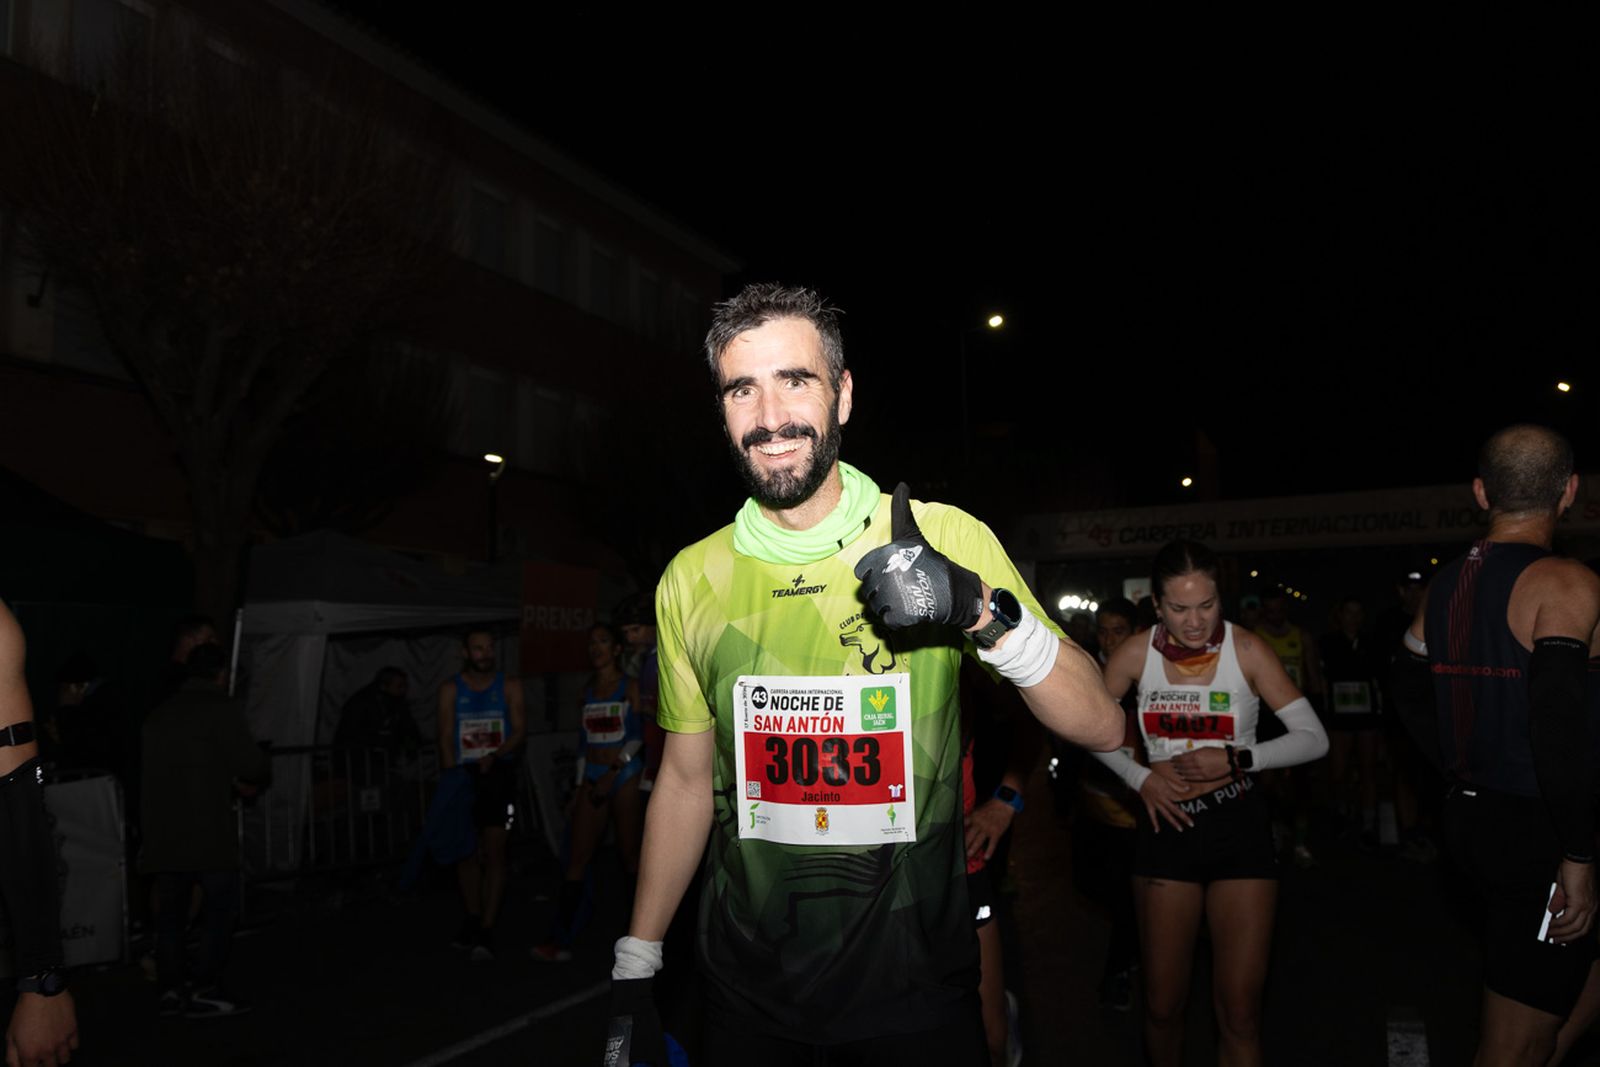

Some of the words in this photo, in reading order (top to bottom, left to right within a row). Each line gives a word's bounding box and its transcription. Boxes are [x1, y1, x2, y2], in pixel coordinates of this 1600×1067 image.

[1088, 524, 1113, 547] 43
[1119, 522, 1217, 544] CARRERA
[1227, 508, 1427, 540] INTERNACIONAL
[1438, 507, 1489, 529] NOC
[771, 583, 828, 599] TEAMERGY
[911, 585, 928, 617] SAN
[523, 604, 596, 632] PRENSA
[839, 615, 855, 630] CLUB
[752, 690, 768, 703] 43
[770, 695, 820, 711] NOCHE
[823, 696, 844, 711] DE
[1159, 692, 1187, 702] NOCHE
[753, 714, 782, 732] SAN
[786, 712, 845, 733] ANTÓN
[765, 736, 881, 787] 3033
[801, 791, 841, 803] Jacinto
[1180, 797, 1208, 815] MA
[1213, 776, 1255, 805] PUMA
[59, 922, 96, 941] AÉN
